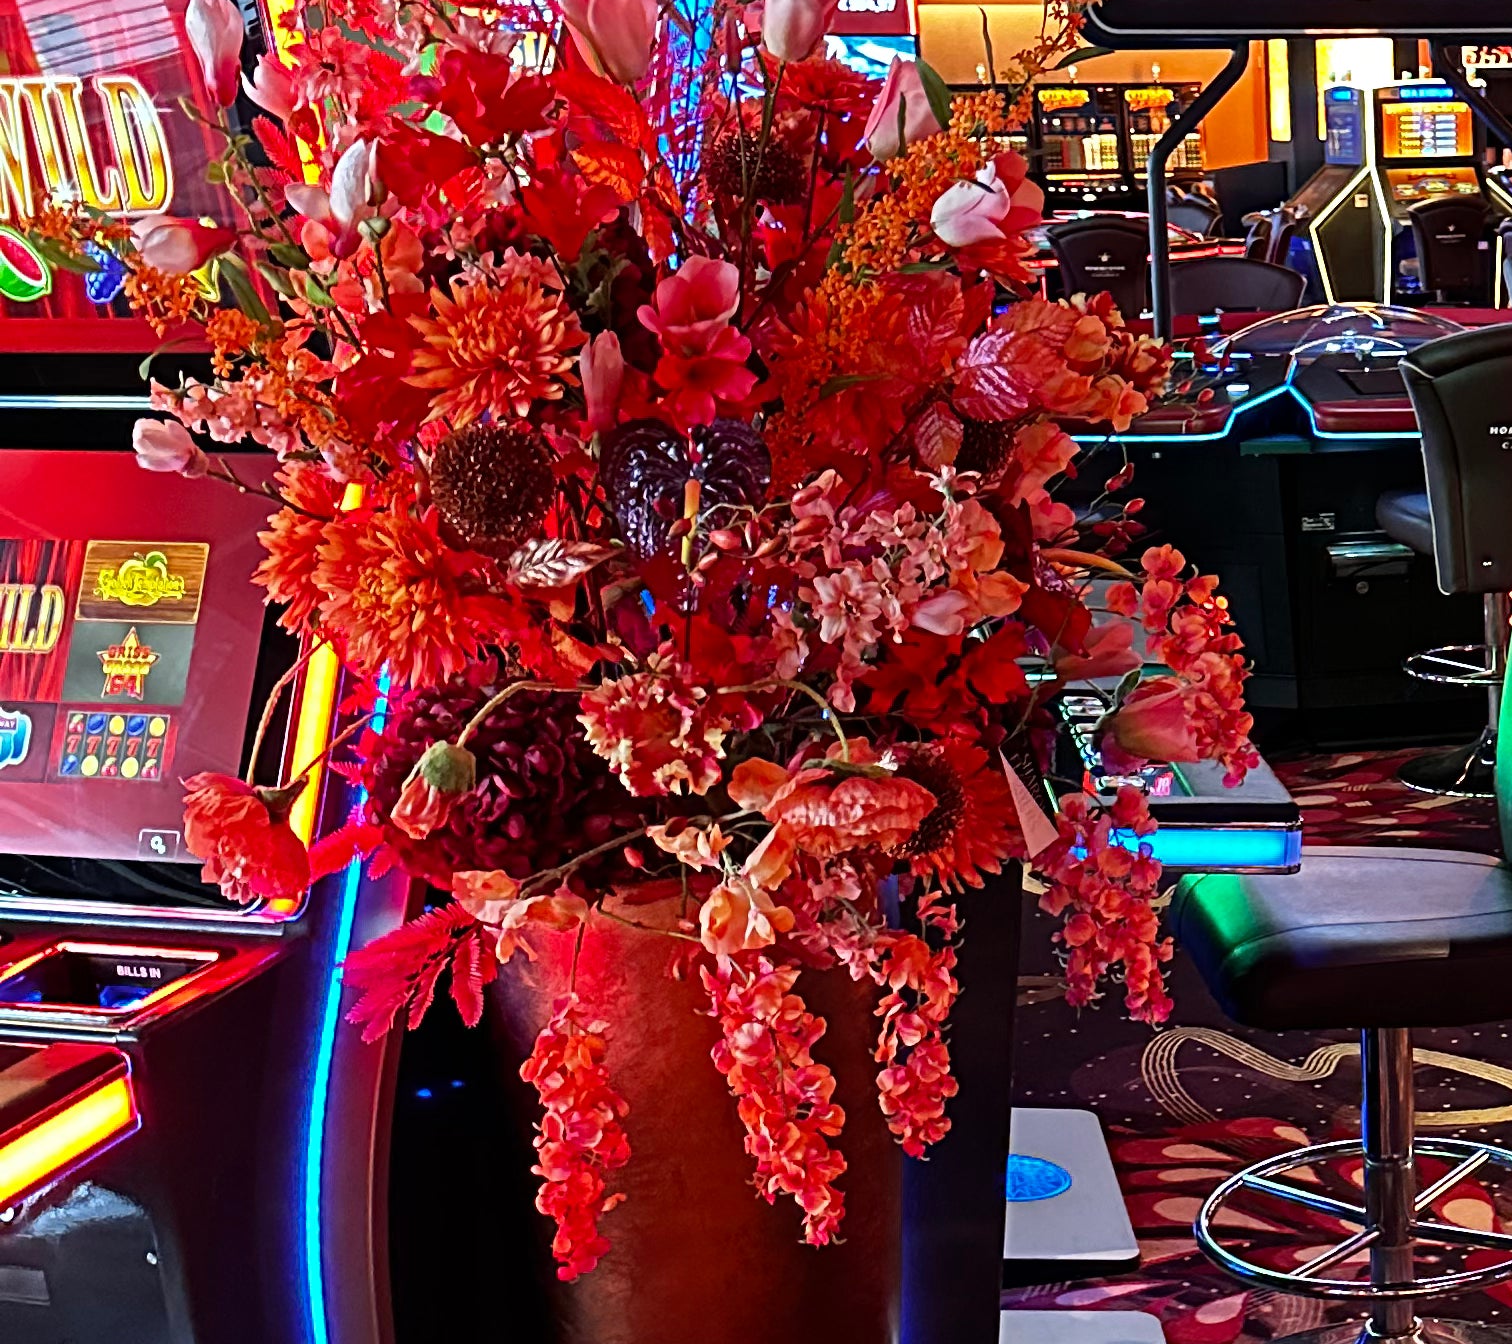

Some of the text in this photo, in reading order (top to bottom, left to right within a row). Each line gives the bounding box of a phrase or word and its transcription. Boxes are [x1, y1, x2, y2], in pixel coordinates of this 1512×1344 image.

[0, 583, 65, 654] ILD
[116, 965, 161, 979] BILLS IN
